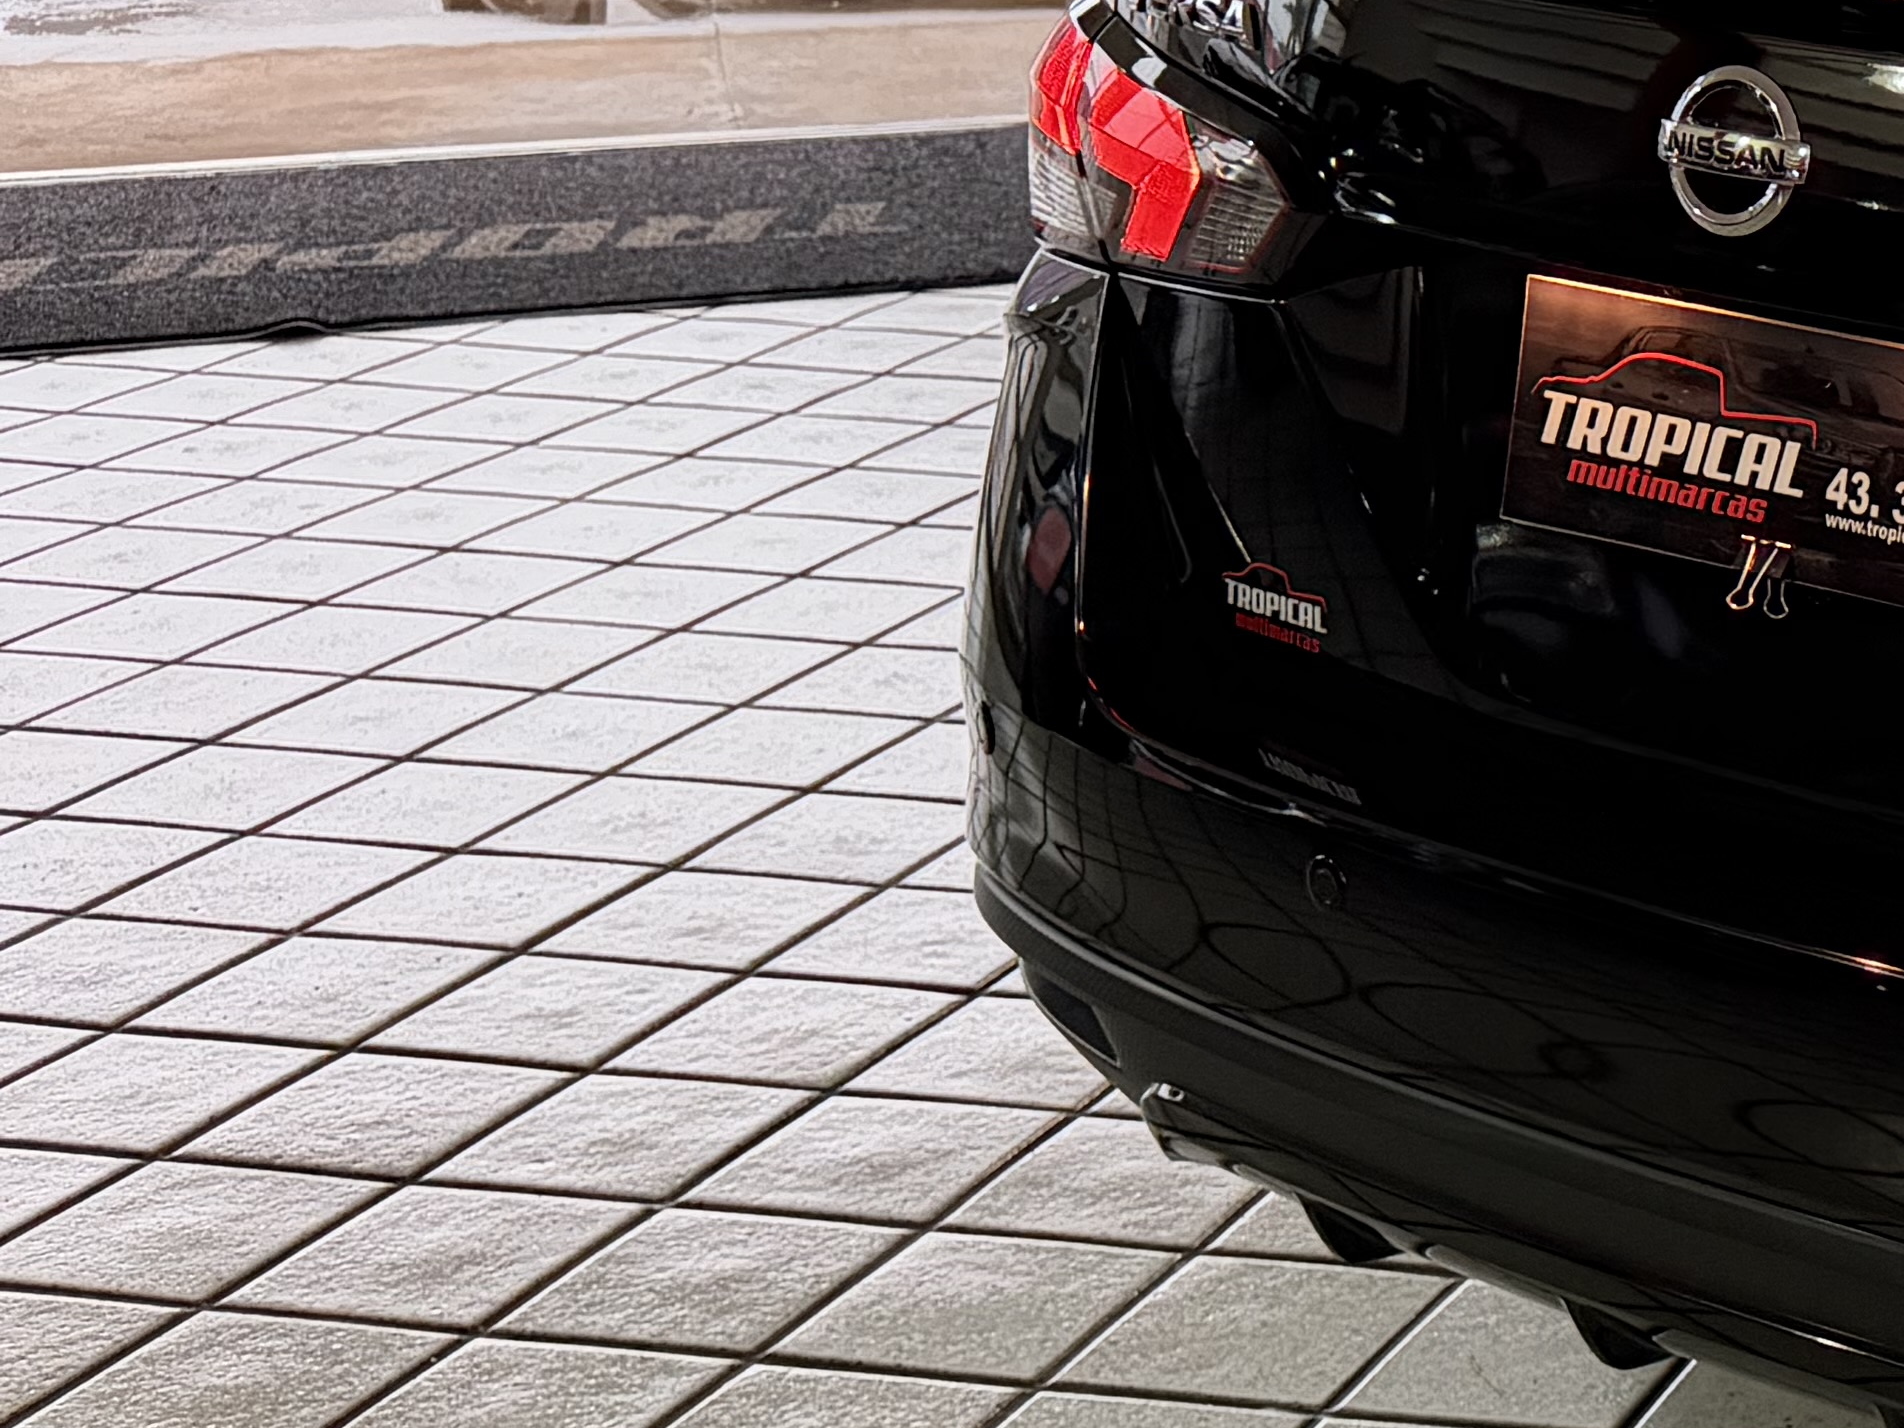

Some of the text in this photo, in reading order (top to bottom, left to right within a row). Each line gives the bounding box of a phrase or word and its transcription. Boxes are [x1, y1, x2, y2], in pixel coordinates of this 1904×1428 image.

[1668, 129, 1785, 178] NISSAN
[1540, 389, 1804, 498] TROPICAL
[1566, 459, 1768, 522] multimarcas
[1825, 467, 1879, 518] 43.
[1224, 577, 1328, 634] TROPICAL
